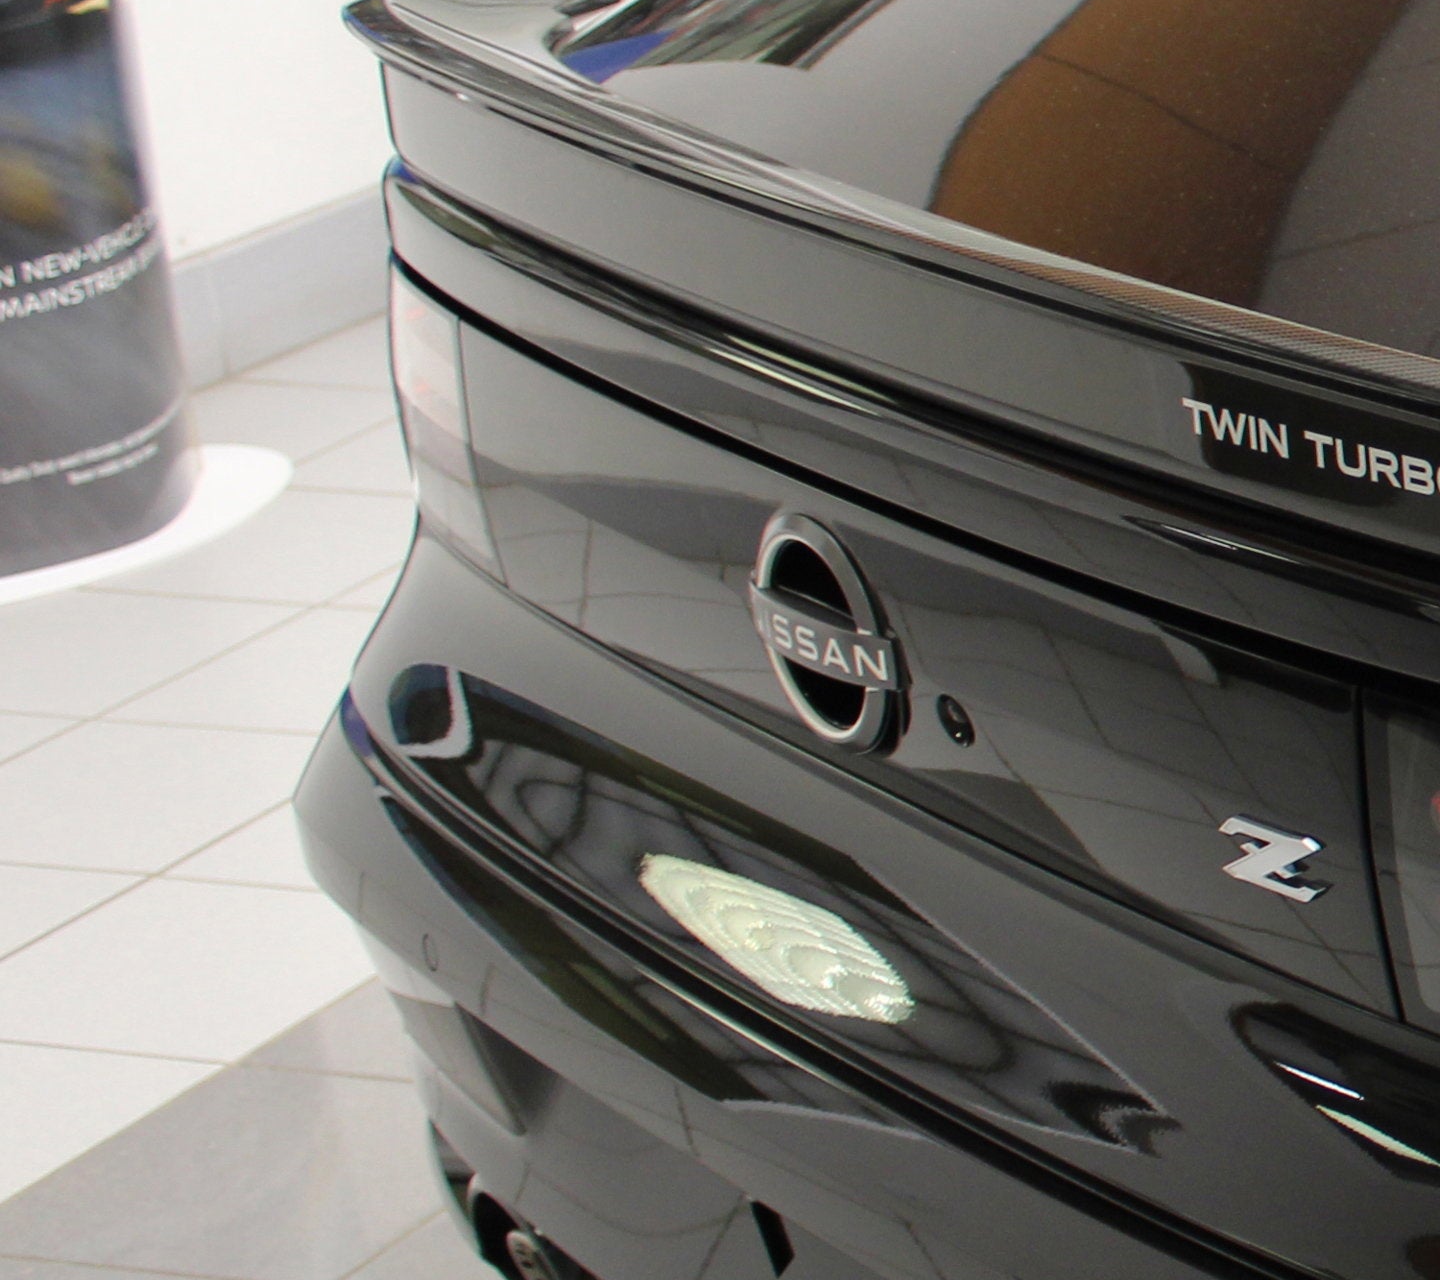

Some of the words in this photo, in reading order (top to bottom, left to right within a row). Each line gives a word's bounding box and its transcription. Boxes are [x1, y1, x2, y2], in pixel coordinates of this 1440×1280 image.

[1182, 396, 1290, 459] TWIN
[755, 604, 889, 681] SSAN
[1218, 813, 1334, 903] Z
